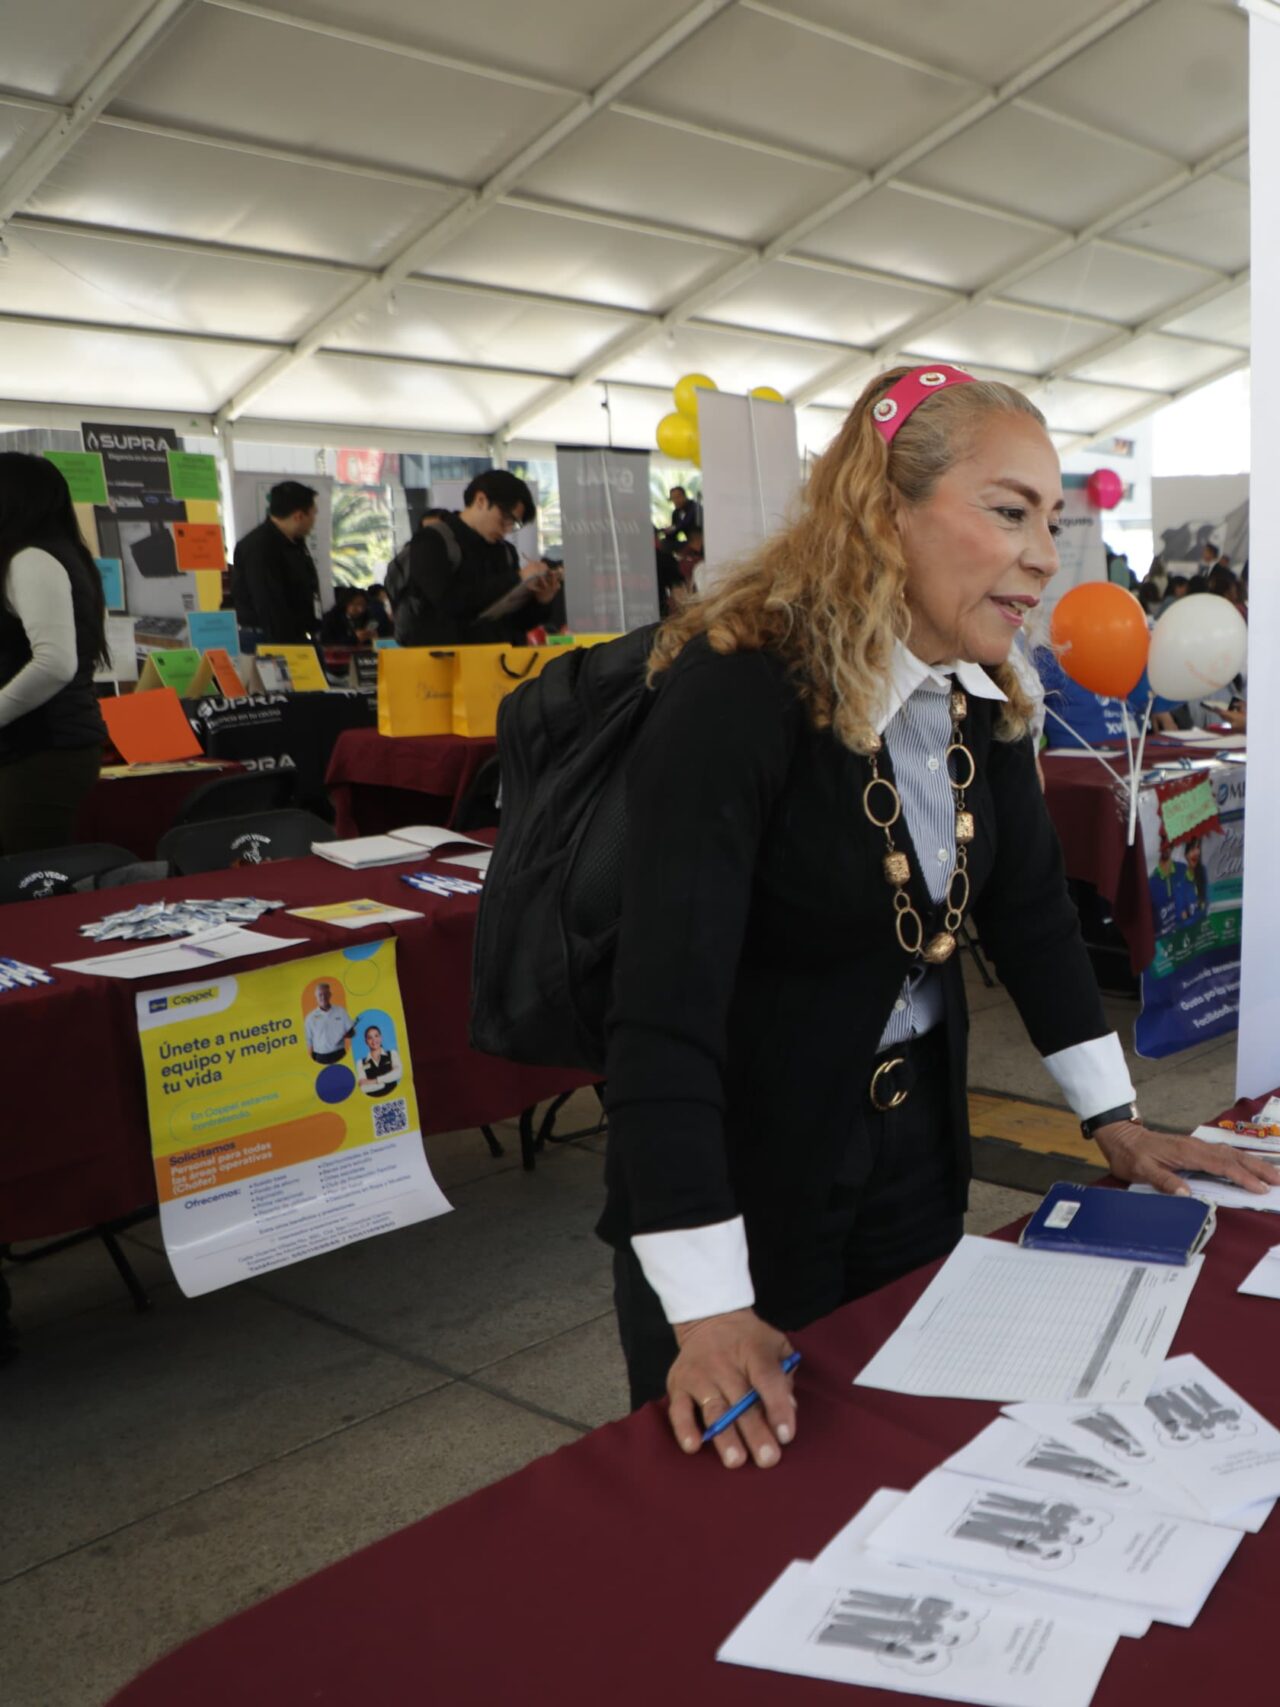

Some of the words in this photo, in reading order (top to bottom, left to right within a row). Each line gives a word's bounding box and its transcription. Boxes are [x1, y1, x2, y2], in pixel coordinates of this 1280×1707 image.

[100, 434, 170, 450] SUPRA
[244, 754, 296, 772] PRA
[159, 1038, 211, 1060] Únete
[215, 1034, 225, 1046] a
[230, 1018, 293, 1043] nuestro
[161, 1051, 221, 1078] equipo
[226, 1049, 236, 1064] y
[240, 1033, 298, 1057] mejora
[162, 1081, 181, 1095] tu
[186, 1068, 222, 1089] vida
[169, 1142, 236, 1166] Solicitamos
[171, 1156, 217, 1175] Personal
[217, 1150, 242, 1164] para
[243, 1142, 272, 1156] todas
[219, 1152, 273, 1173] operativas
[184, 1189, 241, 1210] Ofrecemos:
